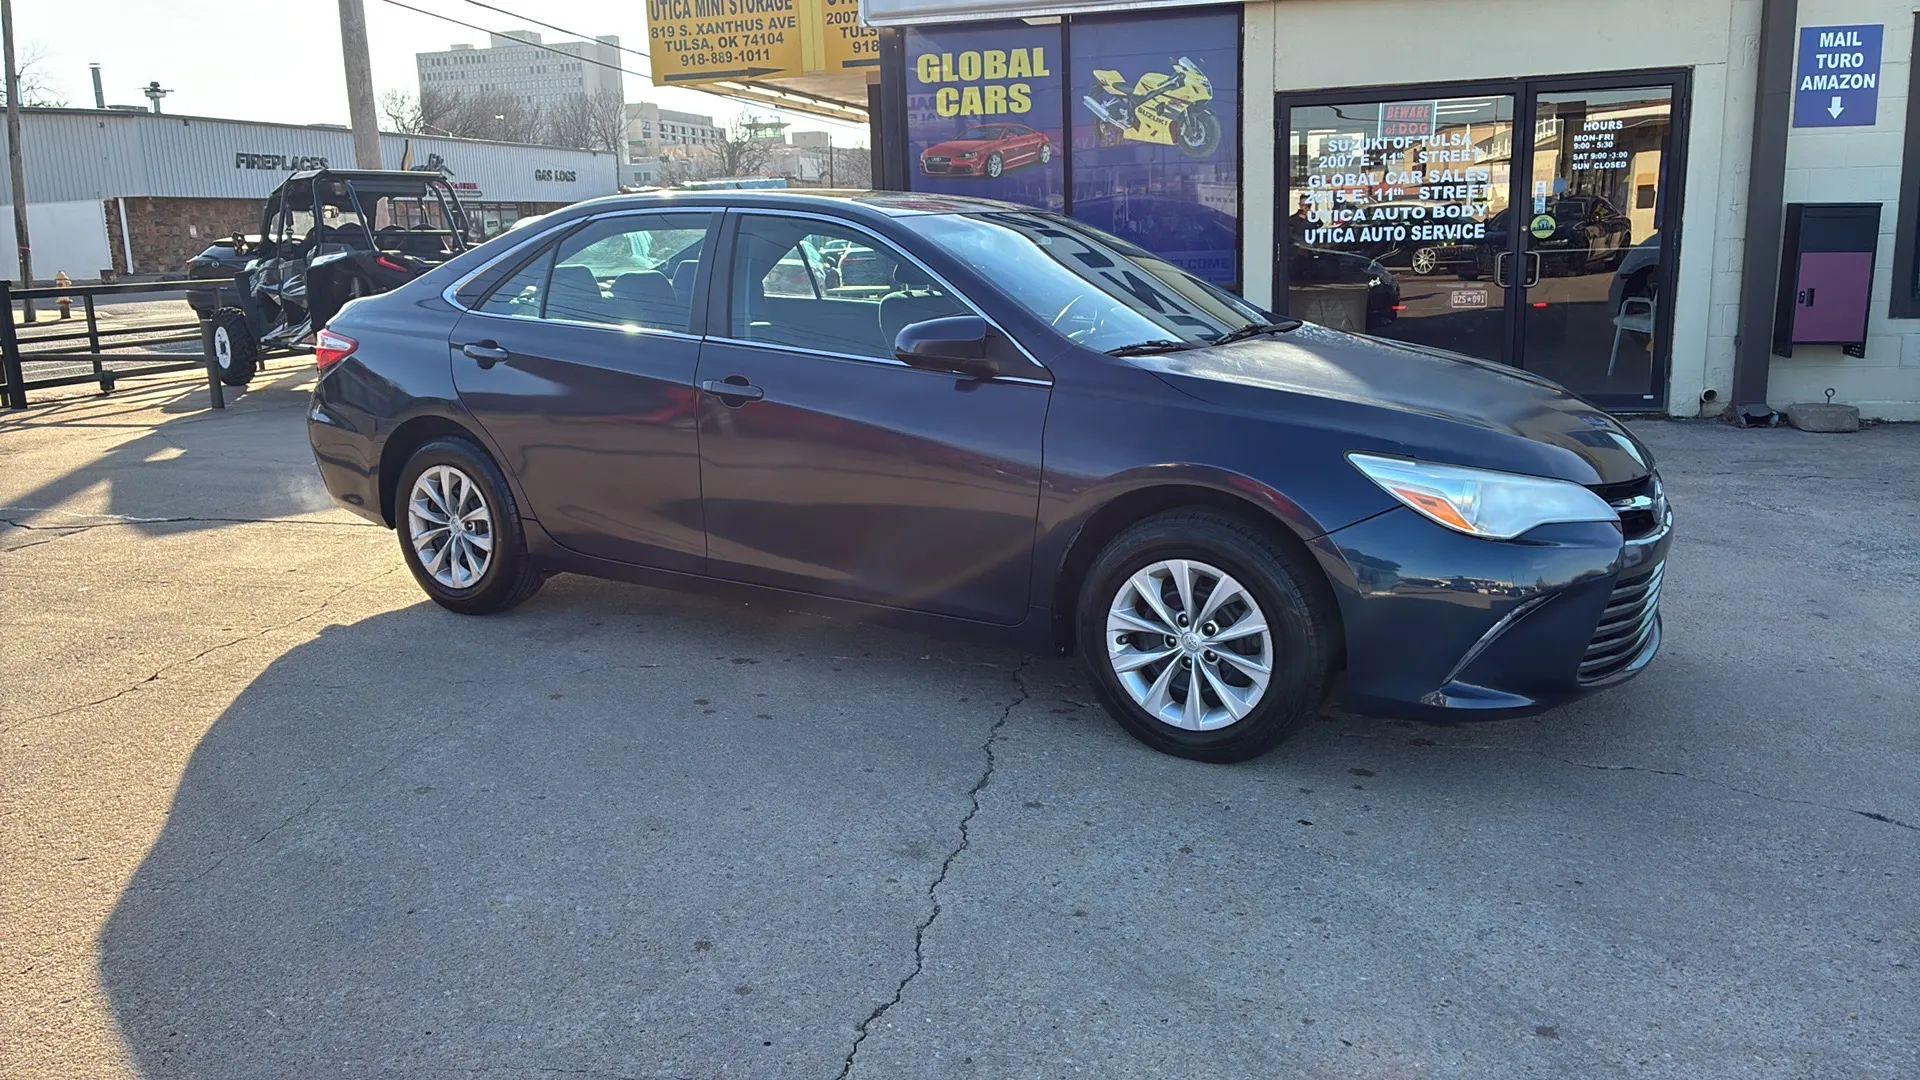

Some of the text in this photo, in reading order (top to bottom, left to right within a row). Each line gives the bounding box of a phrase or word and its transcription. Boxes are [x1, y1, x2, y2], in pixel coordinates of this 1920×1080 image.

[651, 0, 793, 21] UTICA MINI STORAGE
[826, 11, 859, 25] 2007
[651, 16, 796, 39] 819 S. XANTHUS AVE
[664, 32, 785, 52] TULSA, OK 74104
[1819, 31, 1862, 48] MAIL
[680, 48, 770, 67] 918-889-1011
[916, 47, 1050, 84] GLOBAL
[1815, 52, 1864, 69] TURO
[1800, 73, 1876, 91] AMAZON
[935, 83, 1032, 117] CARS
[1137, 106, 1169, 126] SUZUKI
[1386, 104, 1430, 120] BEWARE
[1398, 122, 1430, 135] DOG
[1583, 120, 1623, 131] HOURS
[1328, 133, 1473, 153] SUZUKI OF TULSA
[1573, 133, 1614, 142] MON-FRI
[1596, 141, 1614, 149] 5:30
[235, 152, 329, 171] FIREPLACES
[1318, 155, 1355, 169] 2007
[1360, 153, 1375, 167] E.
[1418, 149, 1482, 164] STREET
[1590, 152, 1608, 160] 9:00
[1593, 161, 1627, 169] CLOSED
[534, 169, 577, 182] GAS LOGS
[1307, 168, 1489, 188] GLOBAL CAR SALES
[1374, 187, 1405, 201] 11th
[1418, 184, 1490, 200] STREET
[1372, 206, 1426, 221] AUTO
[1432, 204, 1488, 219] BODY
[1304, 223, 1485, 244] UTICA AUTO SERVICE
